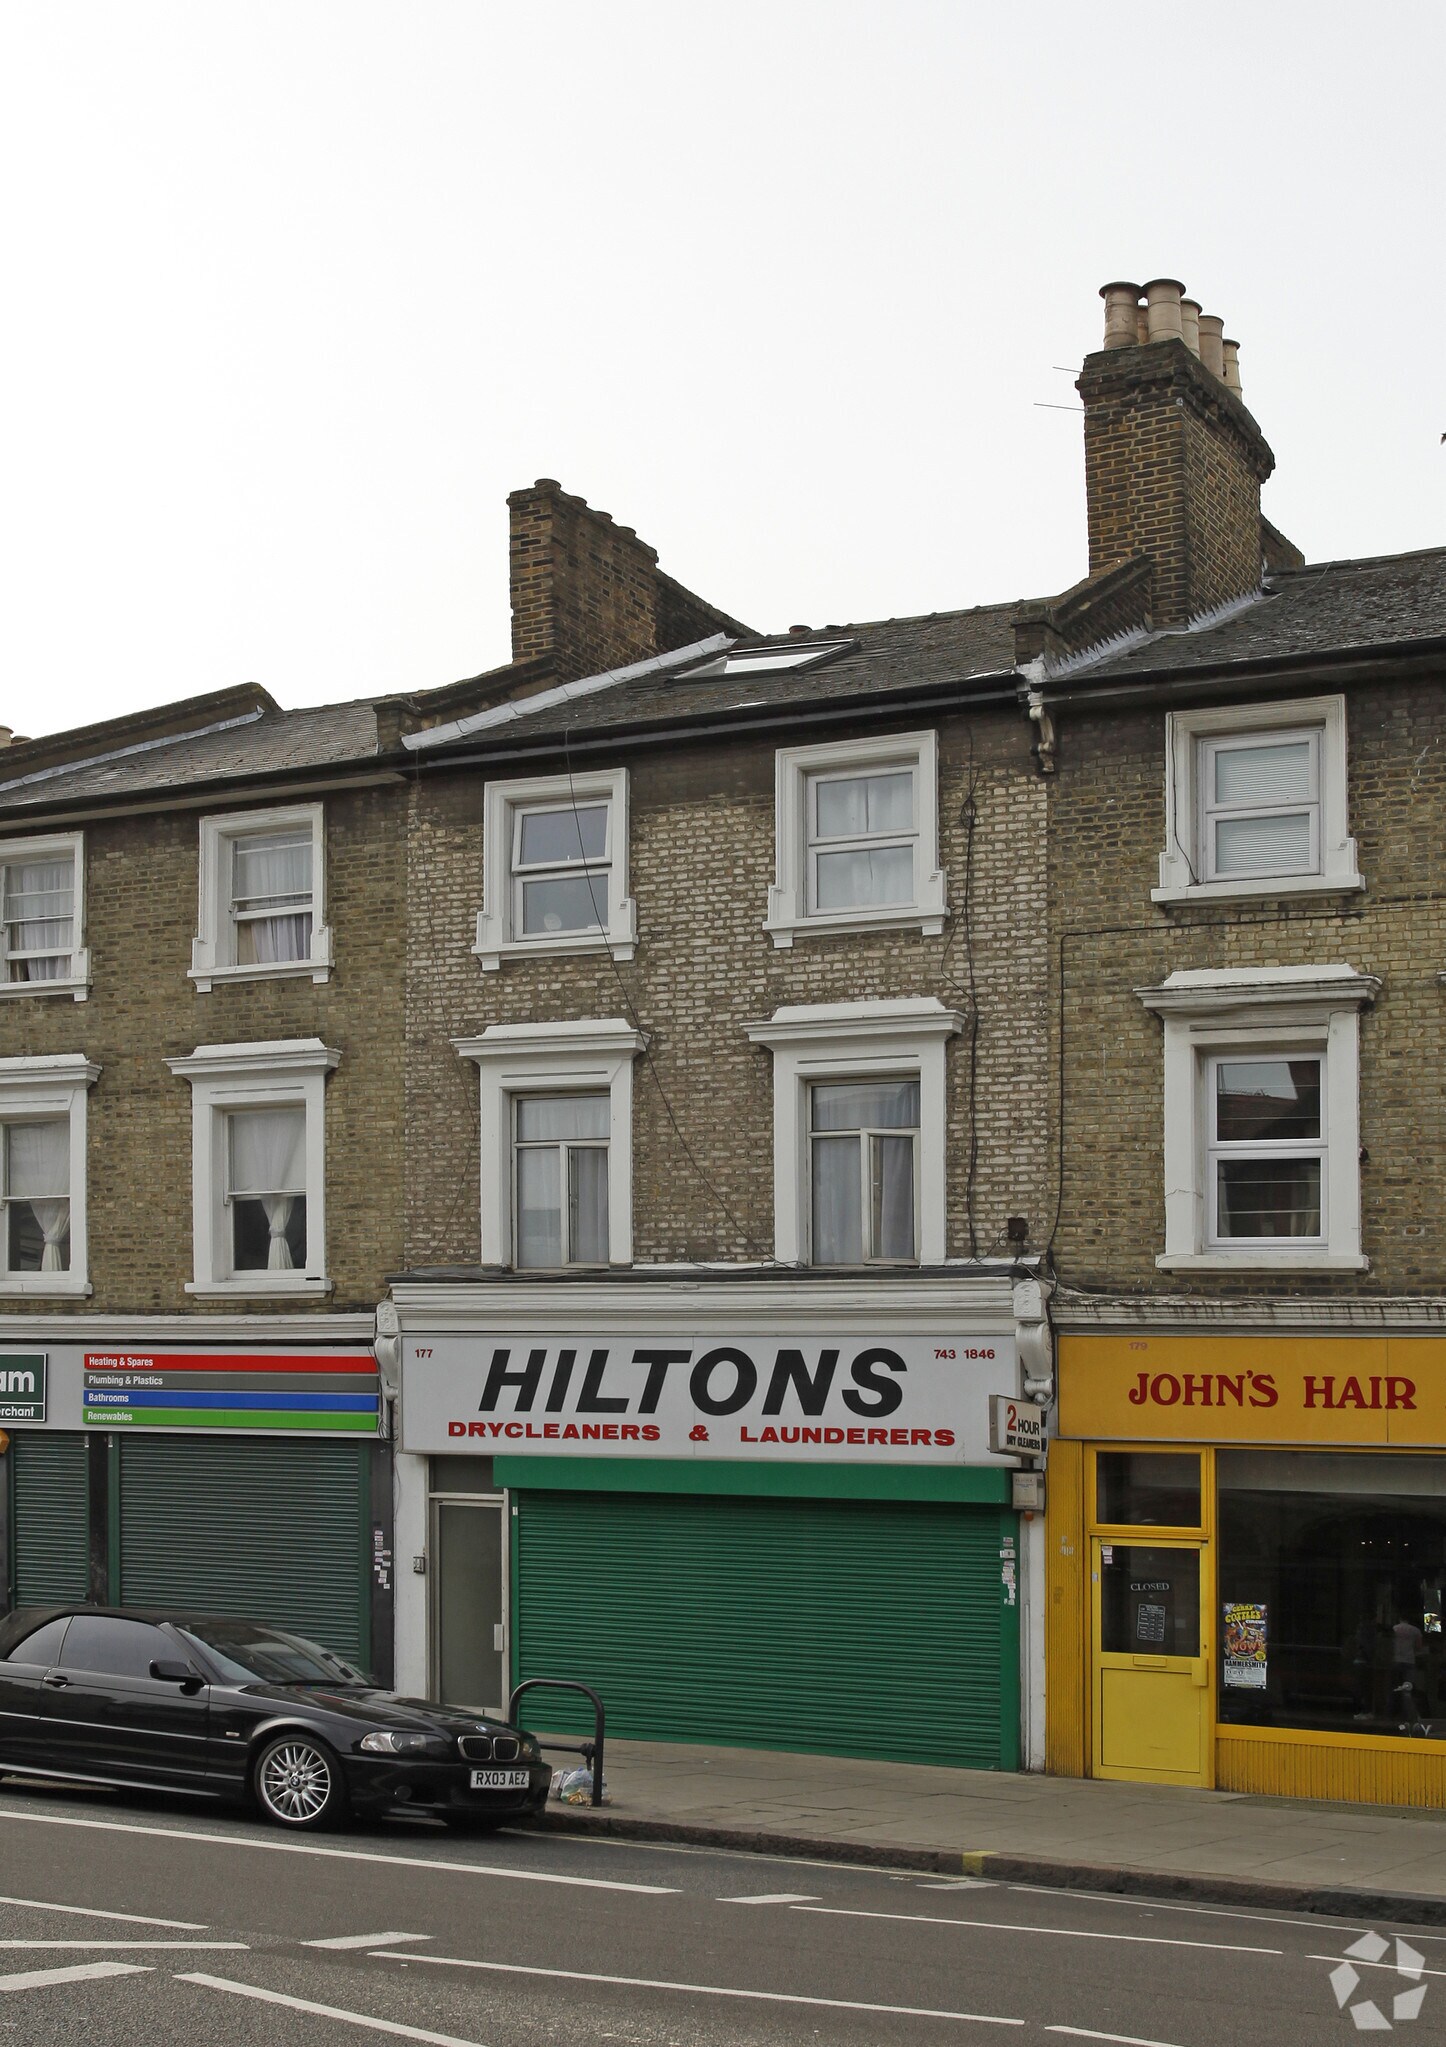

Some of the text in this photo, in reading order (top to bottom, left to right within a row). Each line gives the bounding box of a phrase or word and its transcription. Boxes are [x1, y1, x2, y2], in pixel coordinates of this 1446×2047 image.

[1129, 1342, 1148, 1350] 179
[414, 1349, 433, 1358] 177
[934, 1349, 995, 1359] 743 1846
[89, 1357, 154, 1368] Heating & Spares
[88, 1375, 163, 1386] Plumbing & Plastics
[478, 1347, 907, 1418] HILTONS
[1128, 1370, 1417, 1410] JOHN'S HAIR
[88, 1392, 129, 1403] Bathrooms
[87, 1411, 133, 1421] Renewables
[1007, 1404, 1040, 1436] 2 HOUR
[448, 1421, 955, 1446] DRYCLEANERS & LAUNDERERS
[1007, 1434, 1040, 1450] DRY CLEANERS
[1130, 1583, 1170, 1591] CLOSED
[1225, 1660, 1266, 1669] HAMMERSMITH
[476, 1772, 526, 1786] RX03 AEZ
